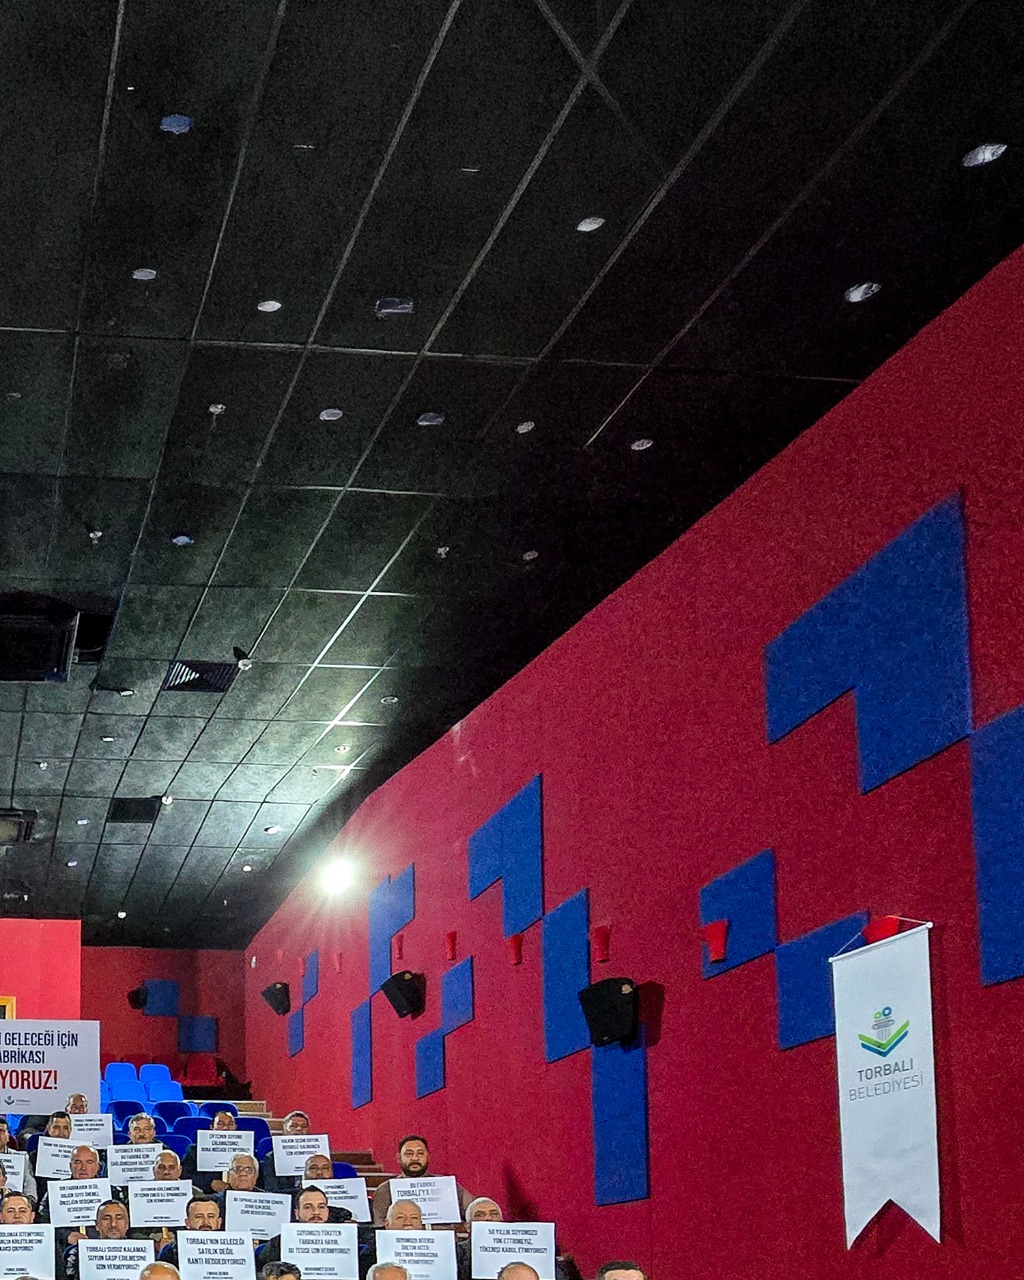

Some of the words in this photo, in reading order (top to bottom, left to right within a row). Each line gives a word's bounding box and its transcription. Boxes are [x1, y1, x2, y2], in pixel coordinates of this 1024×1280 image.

[4, 1030, 54, 1046] GELECEĞİ
[57, 1030, 78, 1048] İÇİN
[857, 1057, 914, 1082] TORBALI
[848, 1070, 925, 1101] BELEDİYESİ
